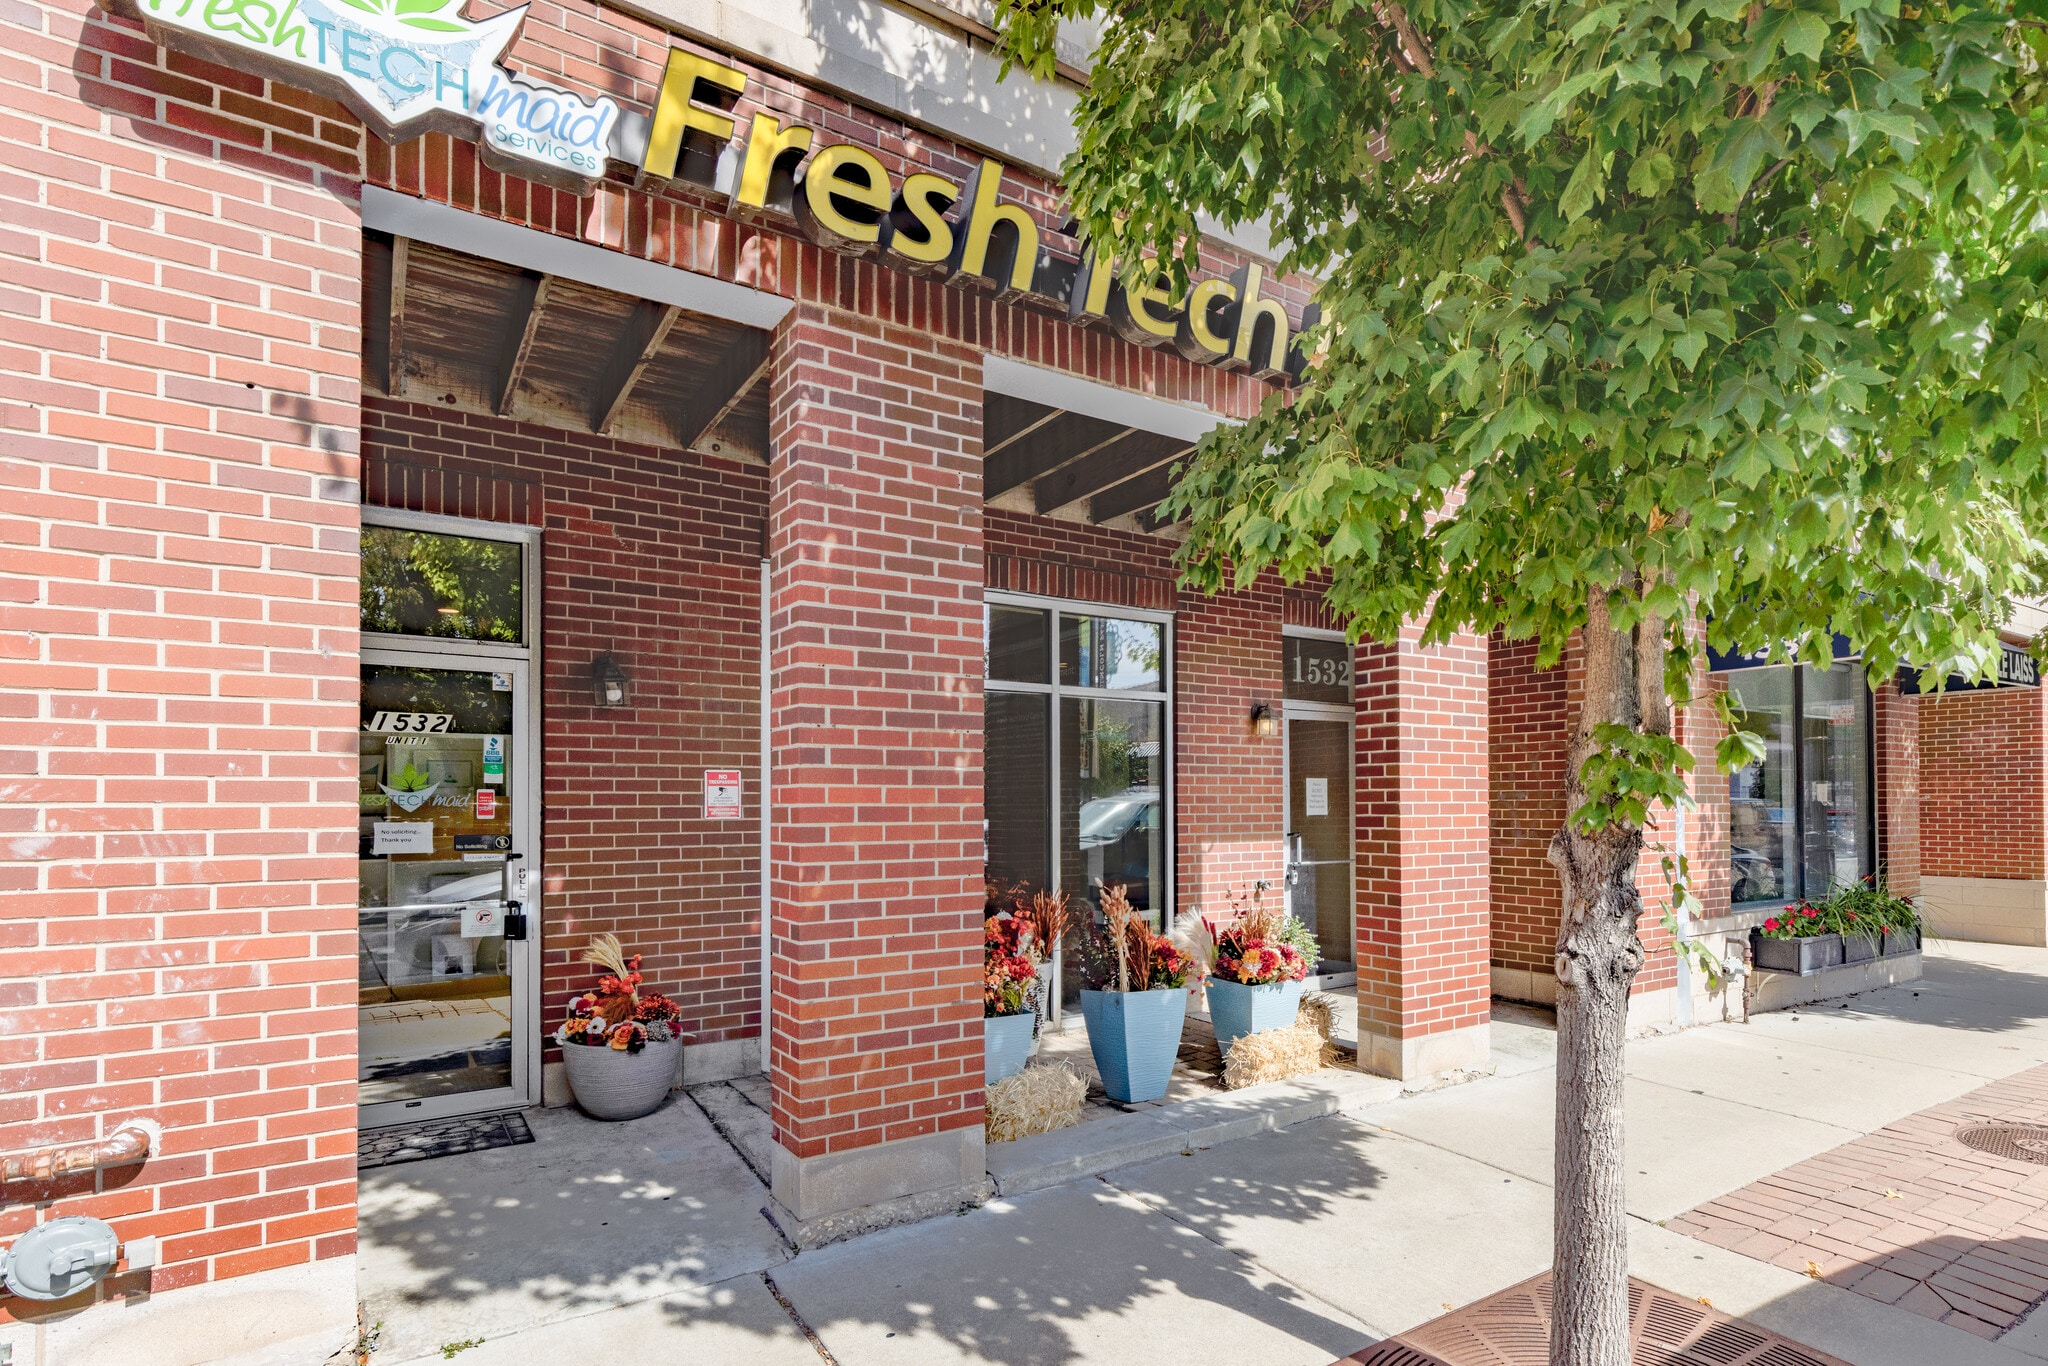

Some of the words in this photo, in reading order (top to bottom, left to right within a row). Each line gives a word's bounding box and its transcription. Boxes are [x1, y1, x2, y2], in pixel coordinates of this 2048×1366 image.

[476, 74, 610, 151] maid
[644, 46, 1040, 291] Fresh
[1292, 656, 1349, 686] 1532
[377, 713, 447, 733] 1532
[387, 737, 417, 745] UNIT
[432, 793, 471, 807] maid
